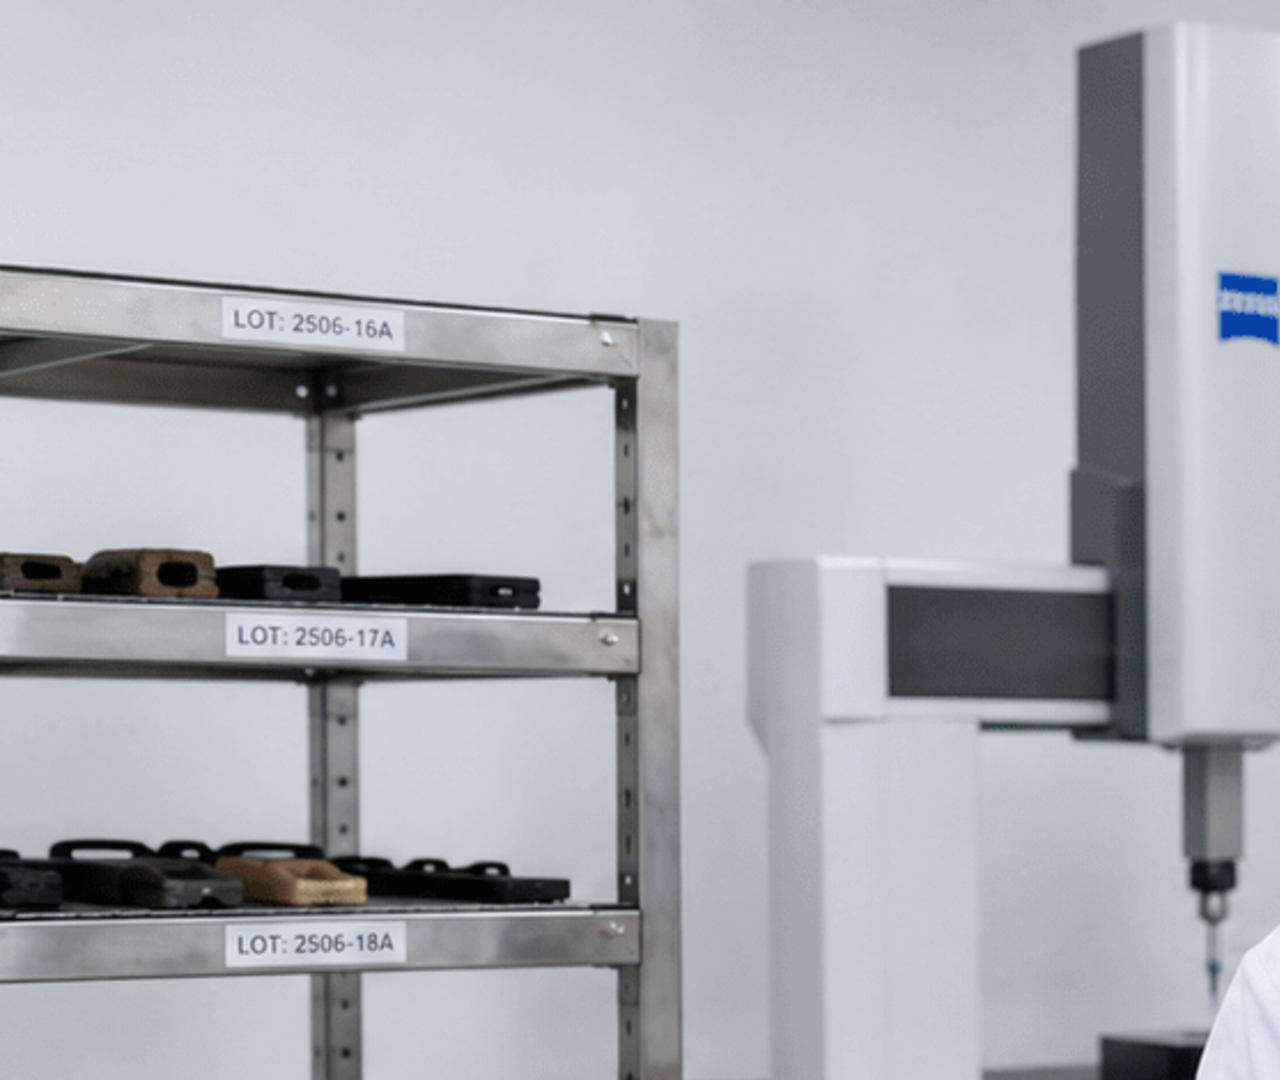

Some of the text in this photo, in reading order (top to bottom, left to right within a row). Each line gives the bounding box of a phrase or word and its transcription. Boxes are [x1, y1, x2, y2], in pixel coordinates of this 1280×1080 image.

[233, 309, 393, 340] LOT: 2506-16A
[237, 625, 396, 648] LOT: 2506-17A
[237, 932, 394, 955] LOT: 2506-18A
